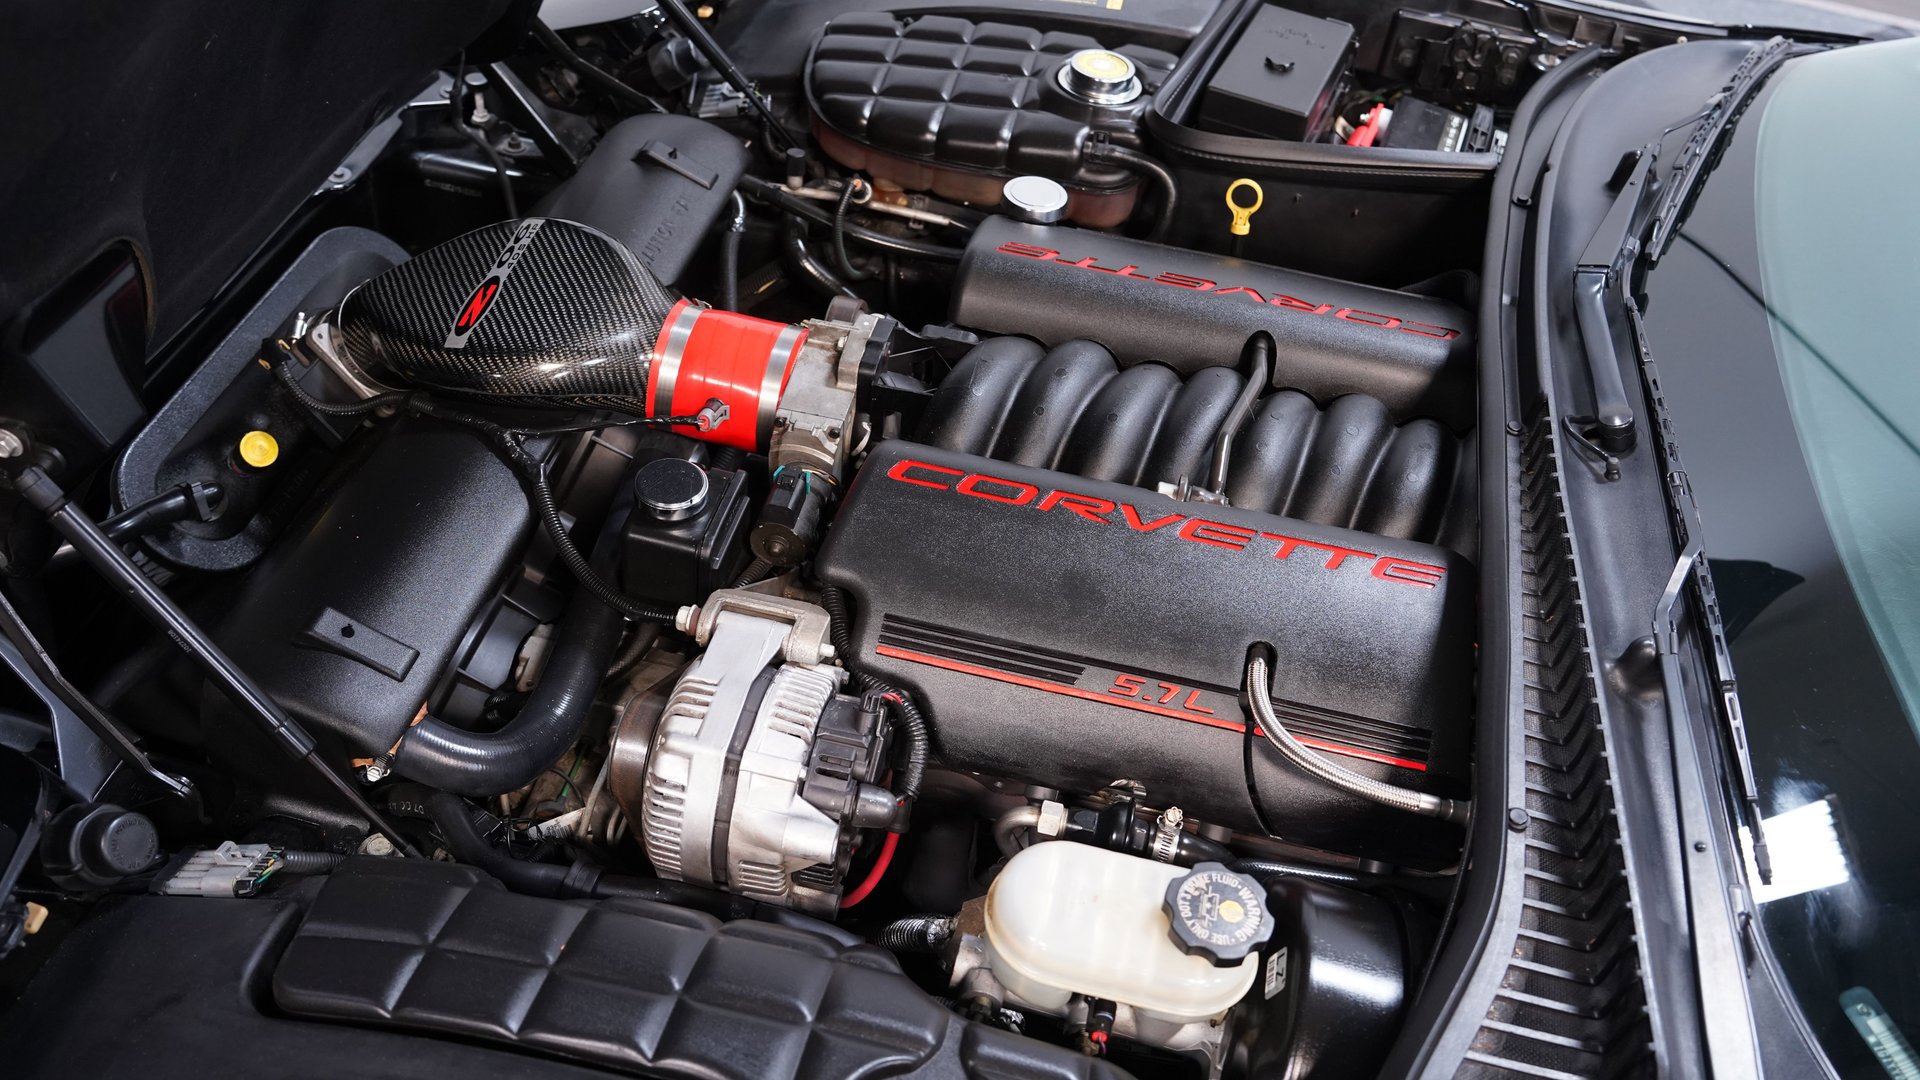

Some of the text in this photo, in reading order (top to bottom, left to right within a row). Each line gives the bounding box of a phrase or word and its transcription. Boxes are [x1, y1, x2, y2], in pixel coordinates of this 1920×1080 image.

[995, 241, 1461, 340] CORVETTE
[886, 459, 1447, 588] CORVETTE
[1108, 673, 1216, 715] 5.7L
[1211, 873, 1239, 888] FLUID
[1184, 918, 1210, 940] ONLY
[1235, 886, 1262, 942] WARNING
[1211, 932, 1232, 946] USE
